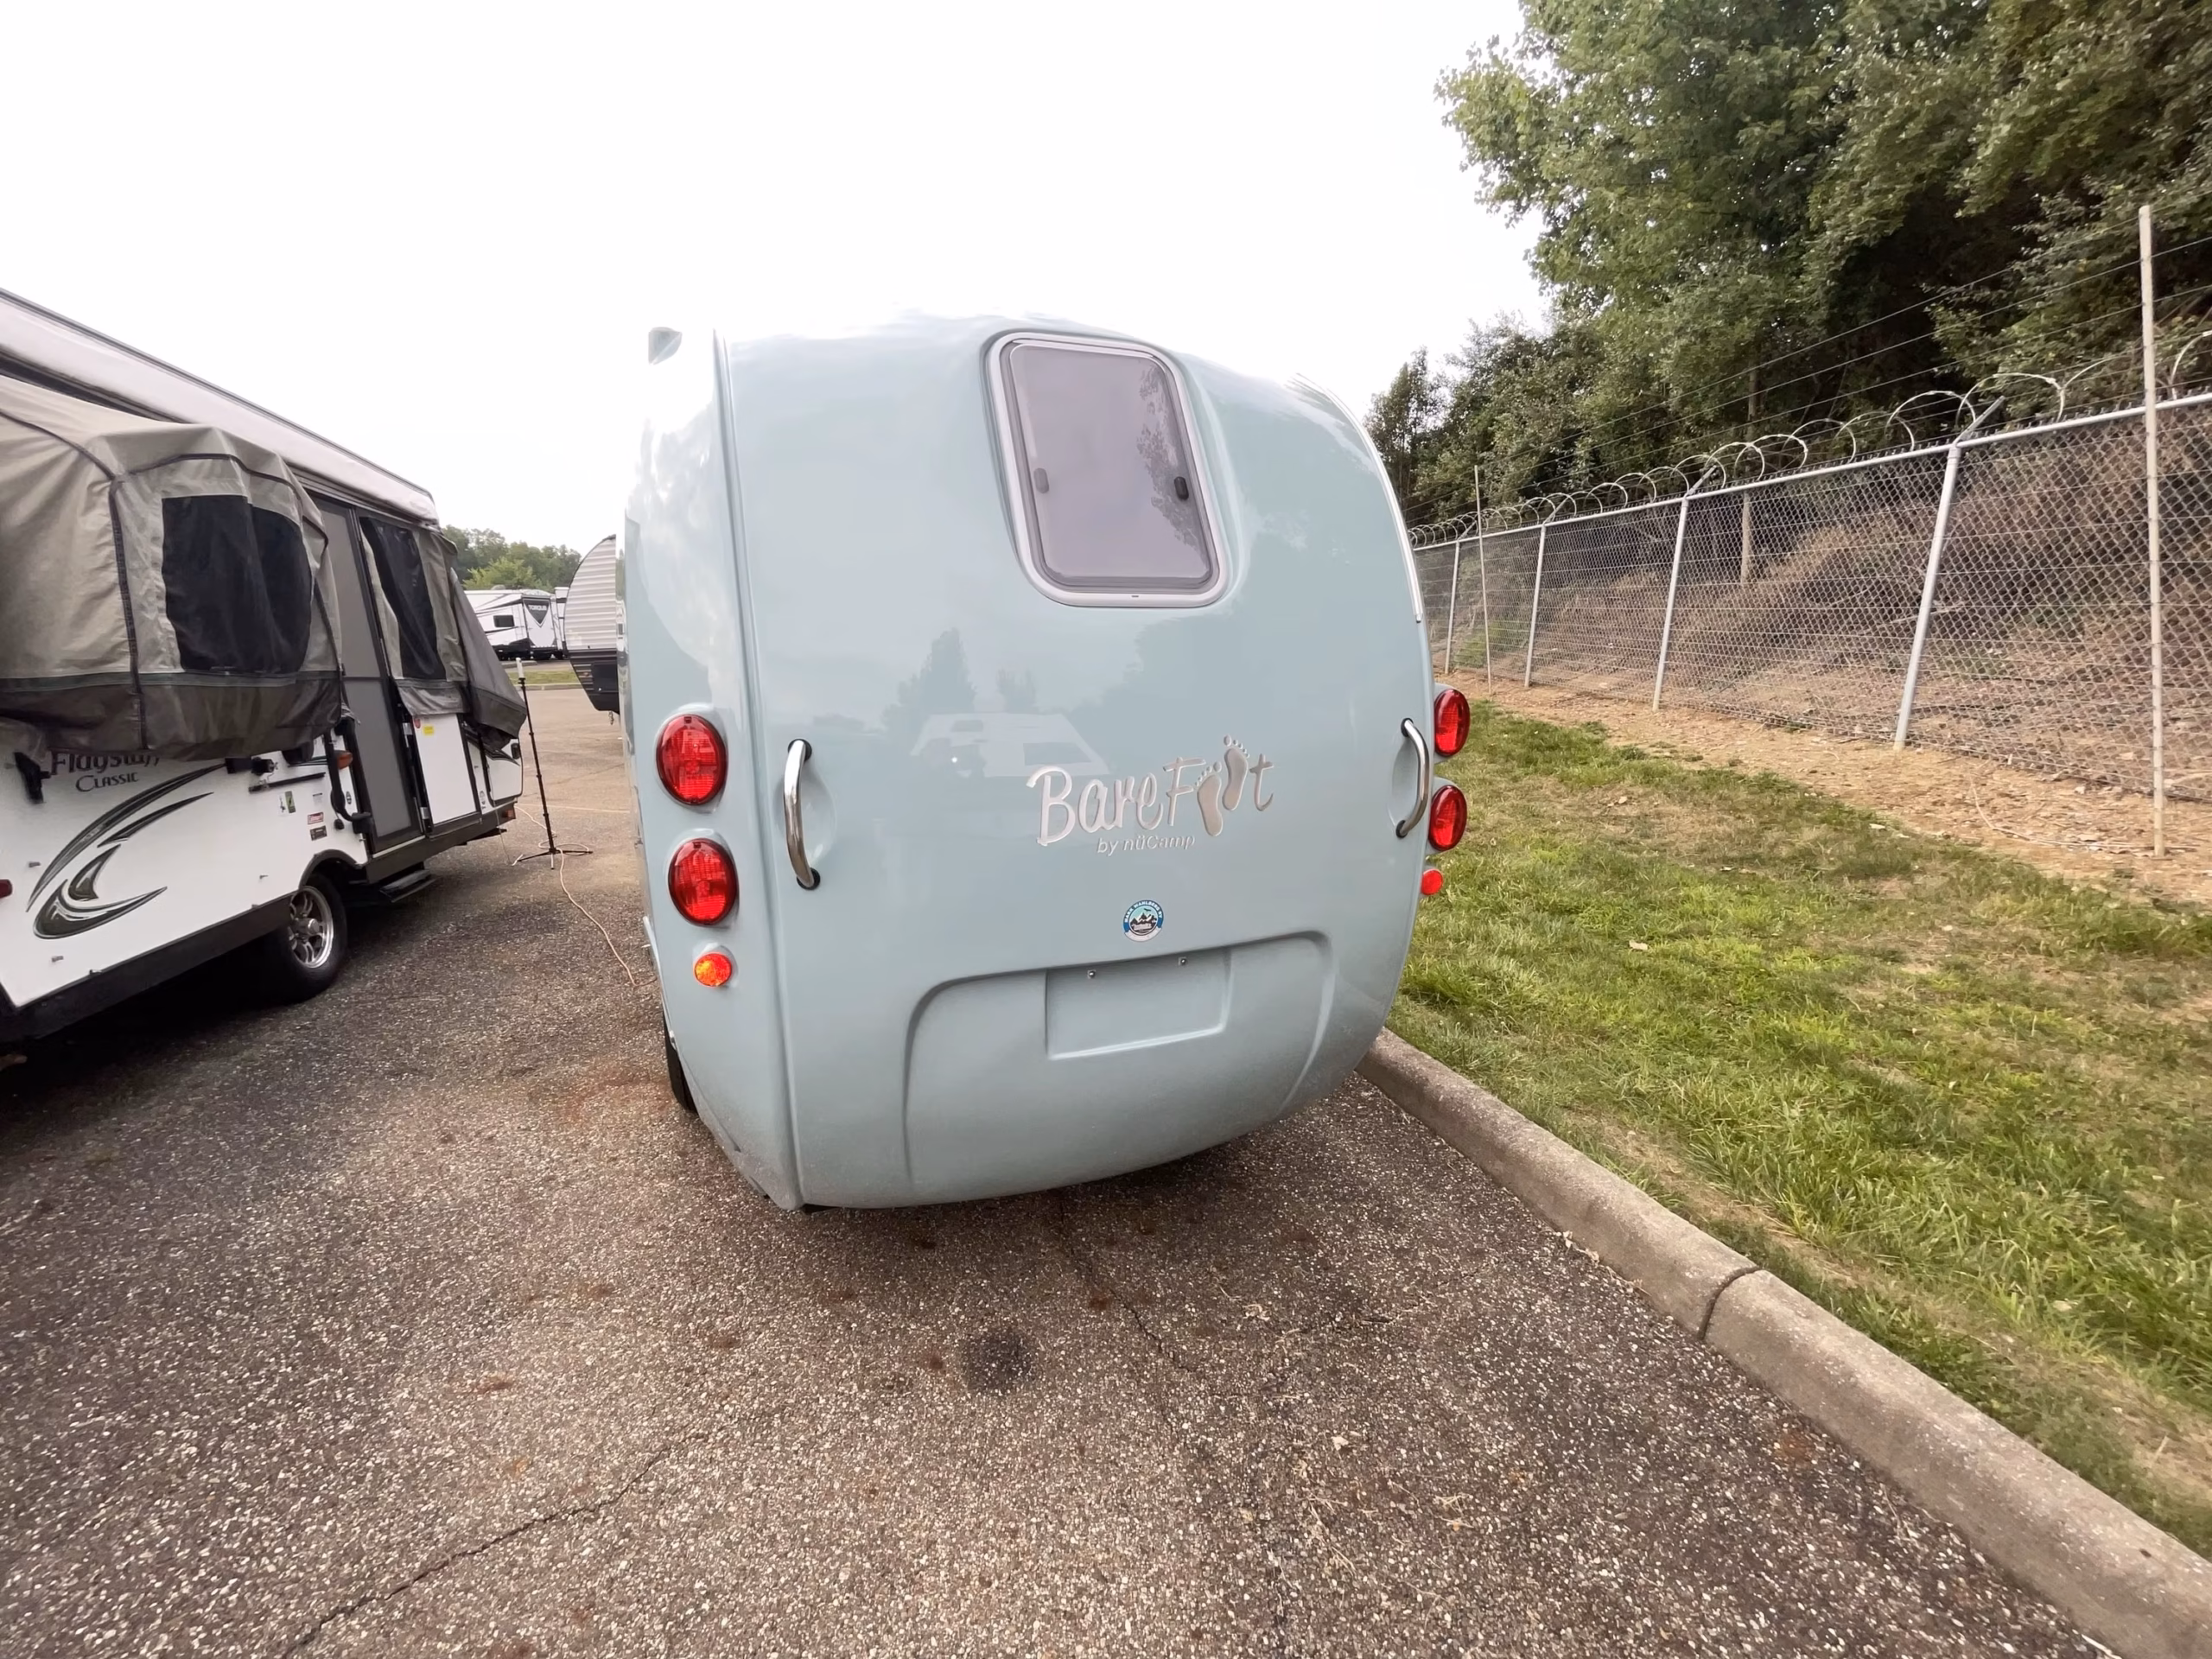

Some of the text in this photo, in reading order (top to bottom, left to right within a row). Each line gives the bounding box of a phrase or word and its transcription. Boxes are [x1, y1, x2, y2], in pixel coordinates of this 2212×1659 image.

[1096, 835, 1196, 856] by nüCamp
[1124, 908, 1134, 922] MARK
[1134, 901, 1160, 911] WAHLBERG
